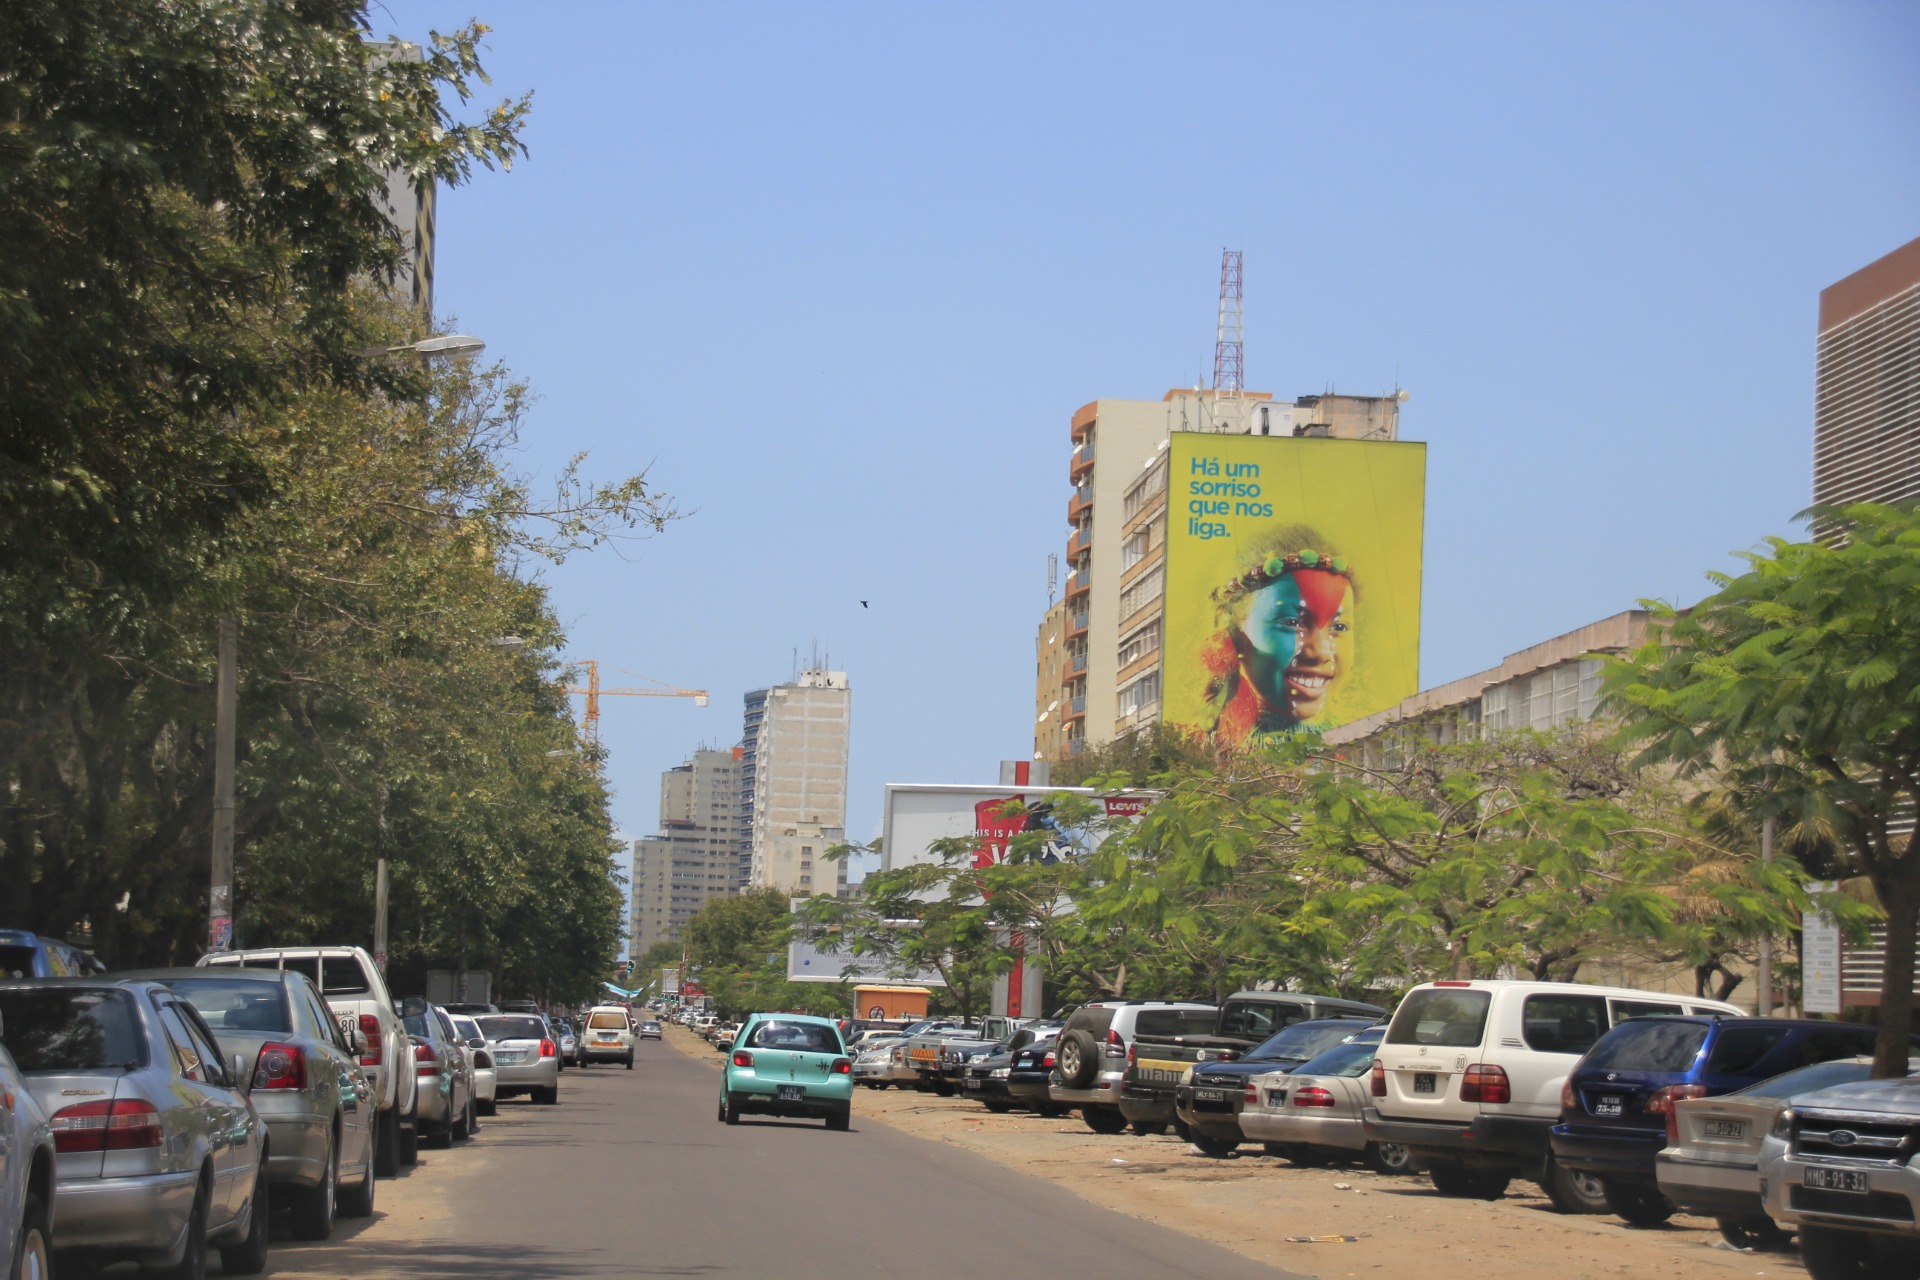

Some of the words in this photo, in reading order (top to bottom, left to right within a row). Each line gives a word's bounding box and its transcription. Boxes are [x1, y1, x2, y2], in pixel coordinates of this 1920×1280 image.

[1191, 457, 1219, 476] Há
[1225, 463, 1260, 478] um
[1189, 478, 1261, 498] sorriso
[1188, 499, 1230, 518] que
[1235, 501, 1273, 517] nos
[1188, 517, 1231, 540] liga.
[993, 829, 1004, 838] IS
[1007, 829, 1014, 838] A
[341, 1019, 355, 1033] 80
[1455, 1057, 1466, 1069] 80
[1806, 1168, 1866, 1190] MMQ-91-31
